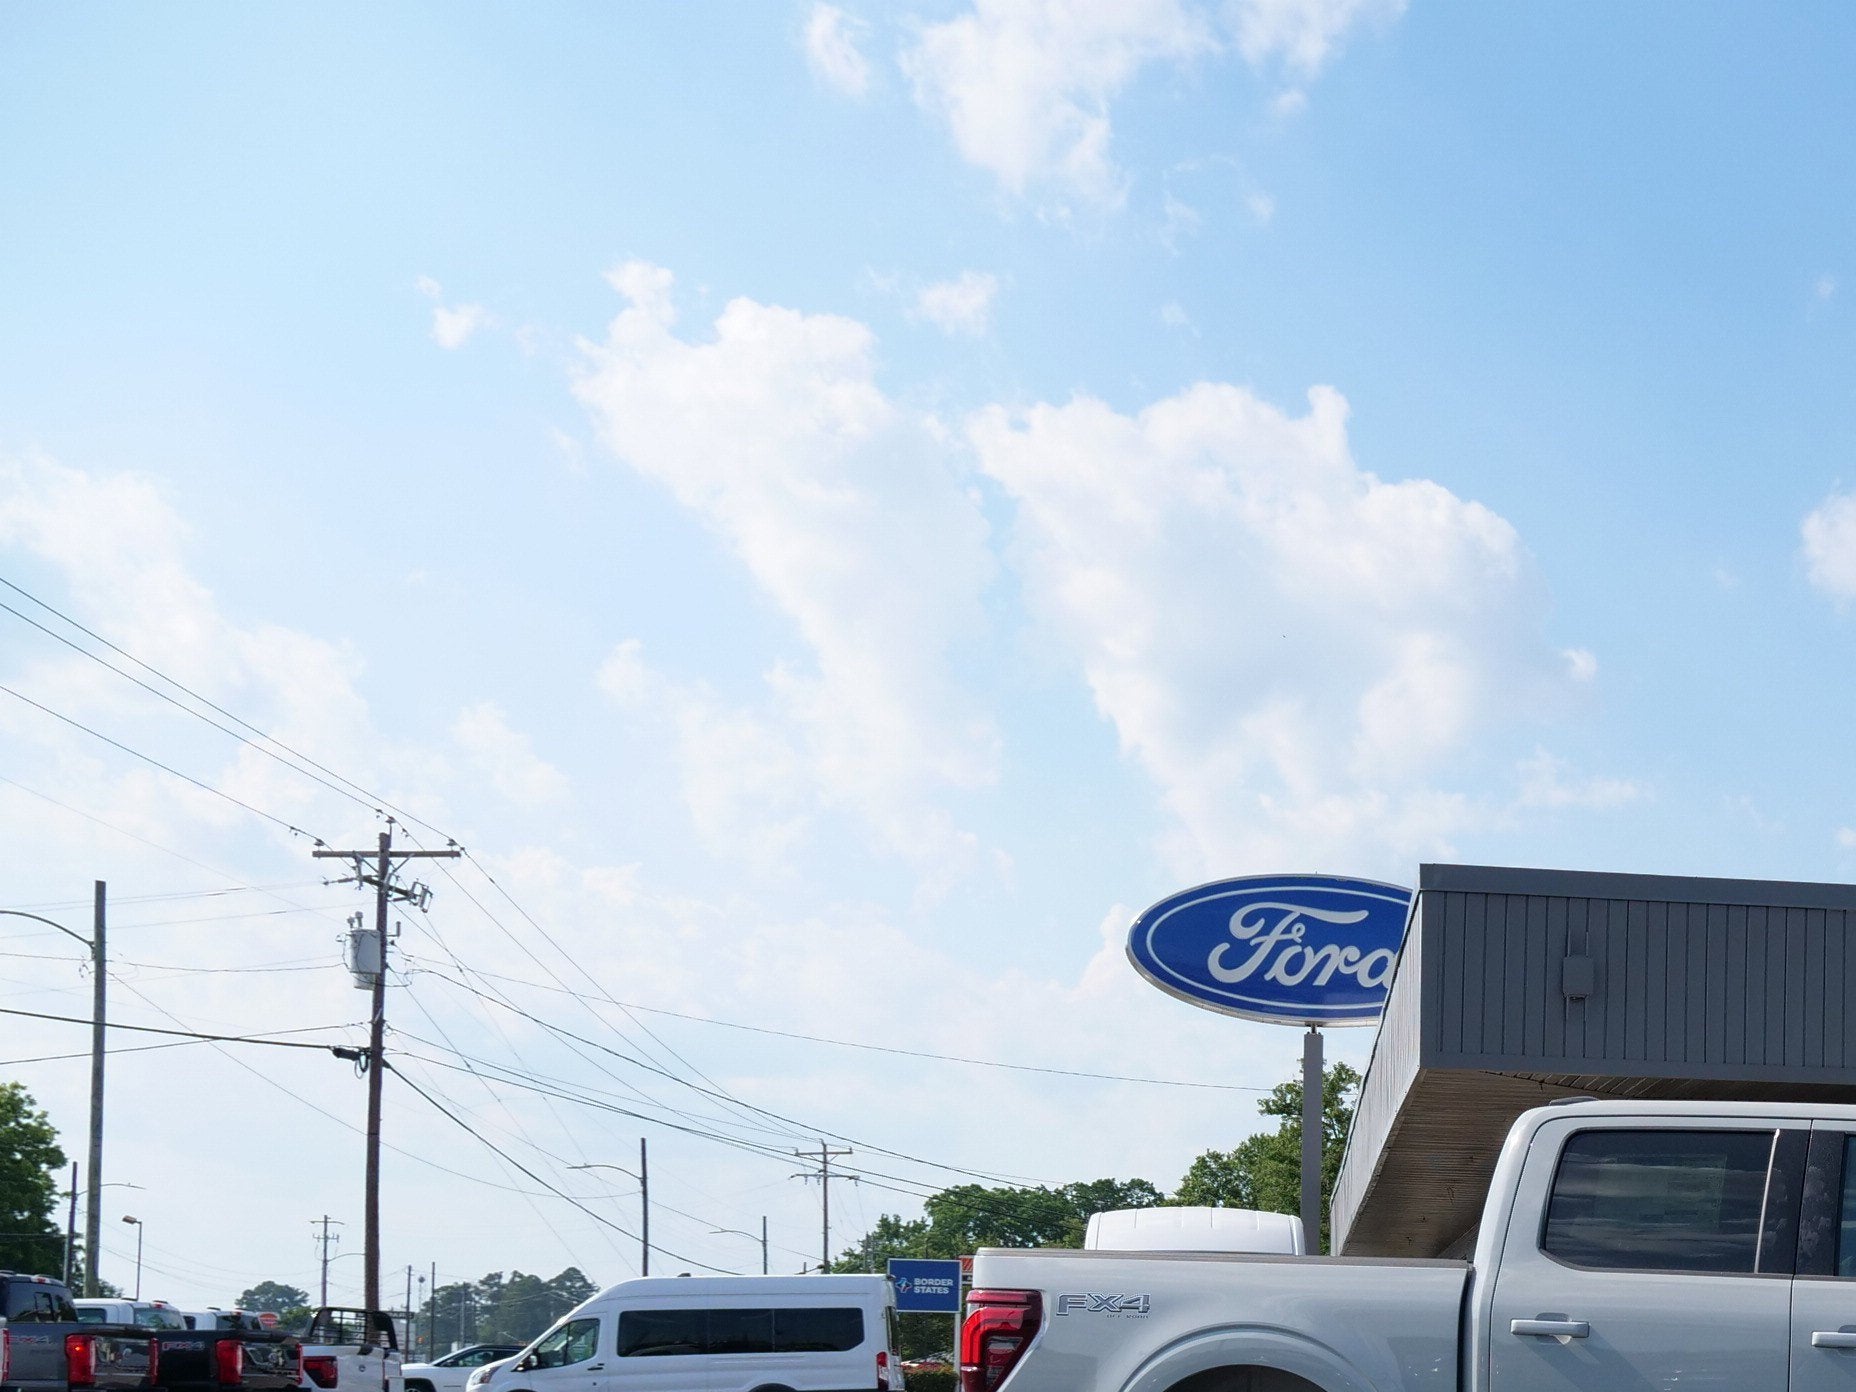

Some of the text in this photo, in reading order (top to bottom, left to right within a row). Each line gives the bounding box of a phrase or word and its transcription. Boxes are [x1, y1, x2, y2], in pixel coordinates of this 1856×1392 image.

[913, 1277, 954, 1287] BORDER
[913, 1286, 950, 1295] STATES
[1055, 1293, 1151, 1317] FX4
